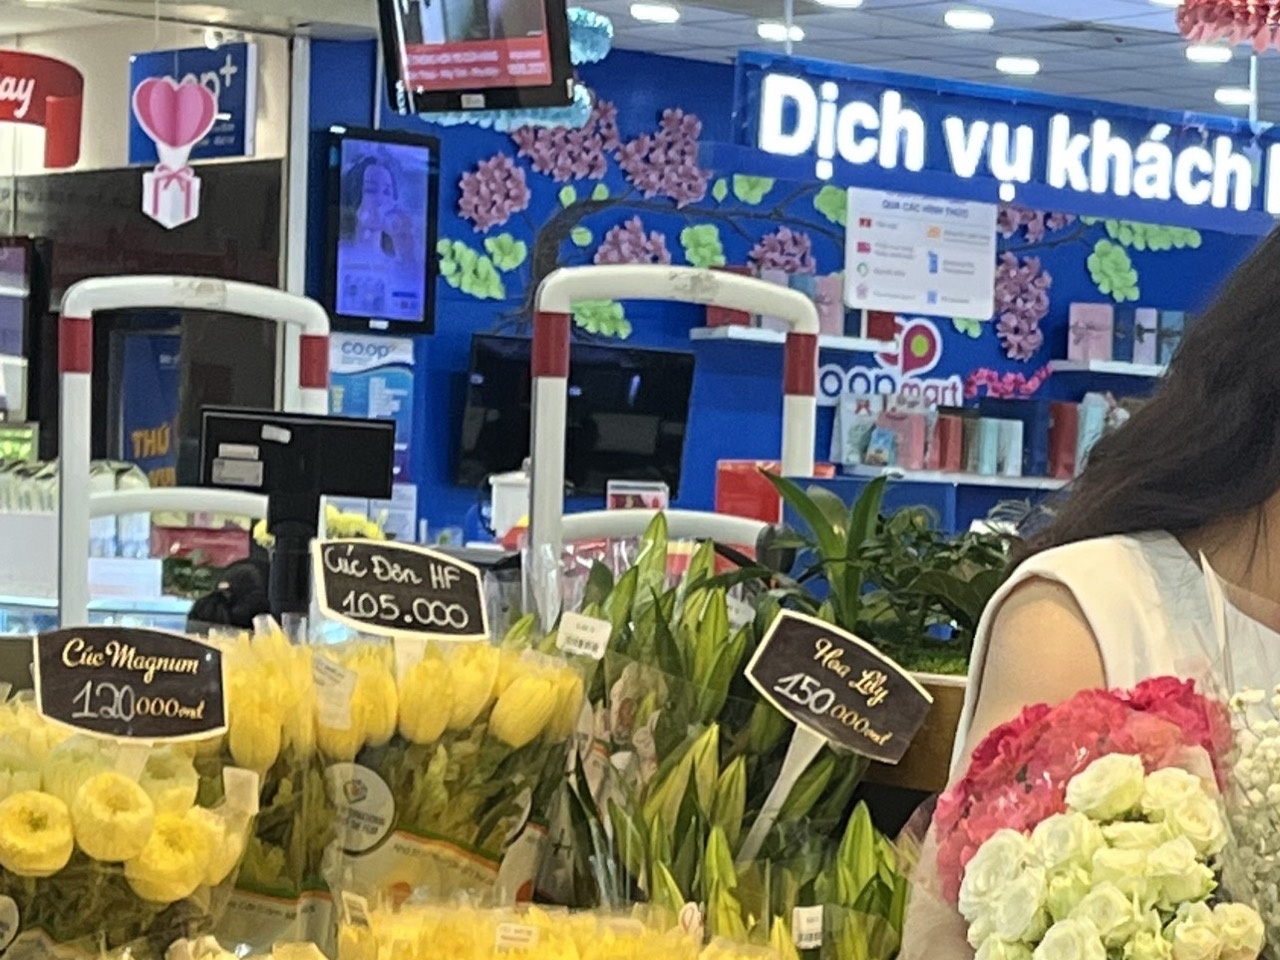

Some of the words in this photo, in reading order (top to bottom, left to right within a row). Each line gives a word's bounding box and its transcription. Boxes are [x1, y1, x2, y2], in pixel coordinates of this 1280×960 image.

[0, 75, 35, 118] ay
[758, 72, 925, 180] Dịch
[942, 116, 1034, 201] vụ
[1046, 113, 1252, 211] khách
[323, 544, 368, 578] Cúc
[429, 562, 461, 590] HF
[342, 590, 469, 629] 105.000
[61, 637, 105, 668] Cúc
[105, 639, 200, 685] Magnum
[813, 637, 851, 679] Hoa
[848, 669, 889, 708] Lily
